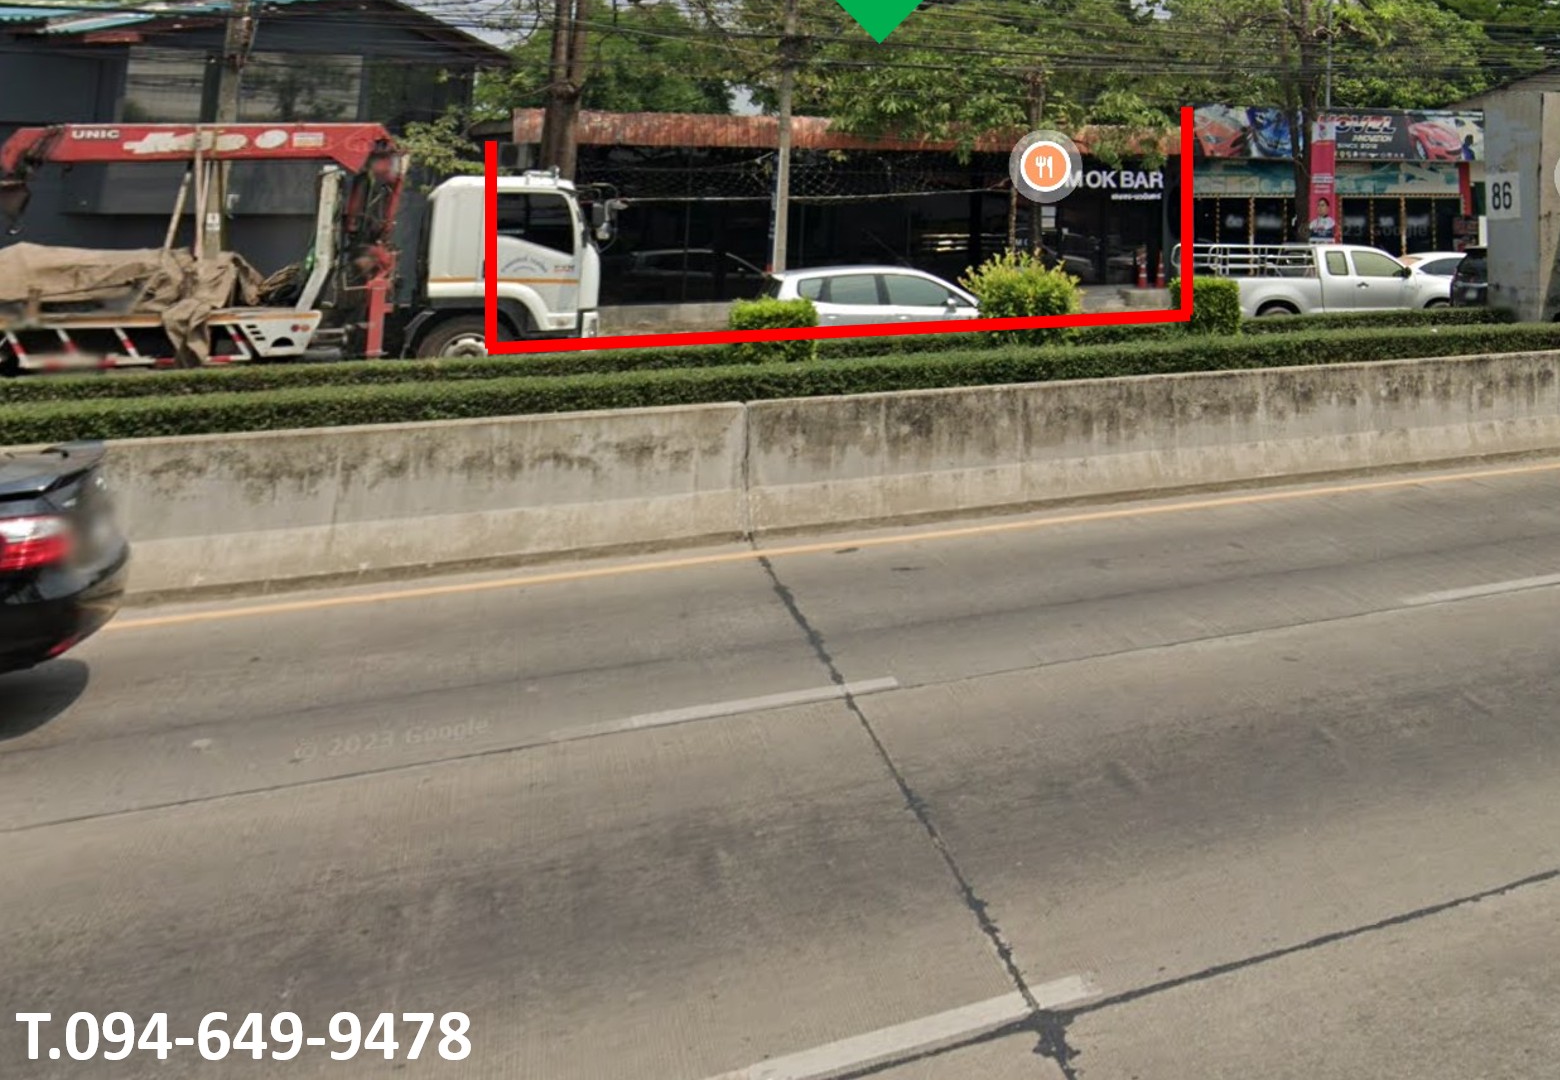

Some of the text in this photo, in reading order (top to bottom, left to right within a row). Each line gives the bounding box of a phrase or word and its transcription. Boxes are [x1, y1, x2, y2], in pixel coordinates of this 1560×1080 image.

[71, 129, 120, 140] UNIC
[1120, 170, 1164, 189] BAR
[1492, 181, 1512, 210] 86
